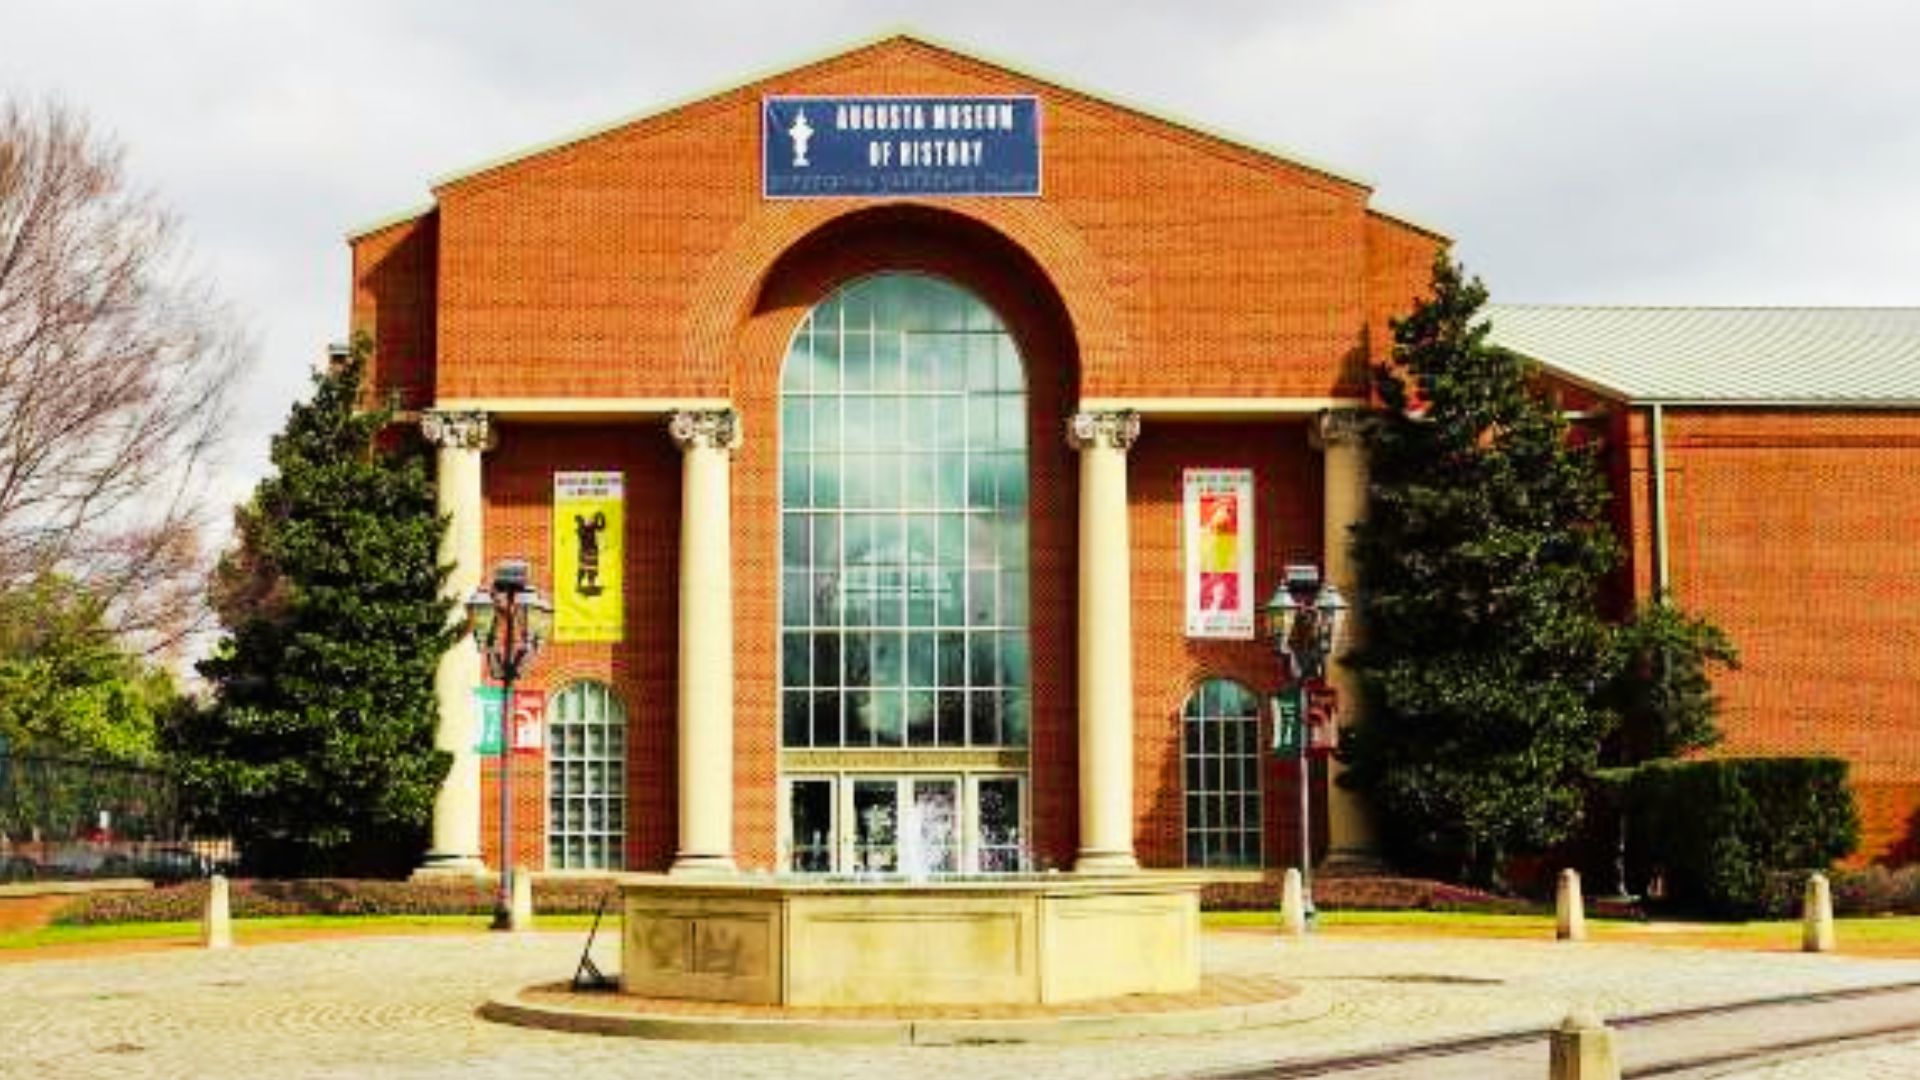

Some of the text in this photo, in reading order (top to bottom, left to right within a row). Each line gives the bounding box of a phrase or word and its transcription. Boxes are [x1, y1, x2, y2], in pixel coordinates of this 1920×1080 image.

[836, 104, 1013, 130] AUGUSTA MUSEUM
[869, 141, 983, 167] OF HISTORY
